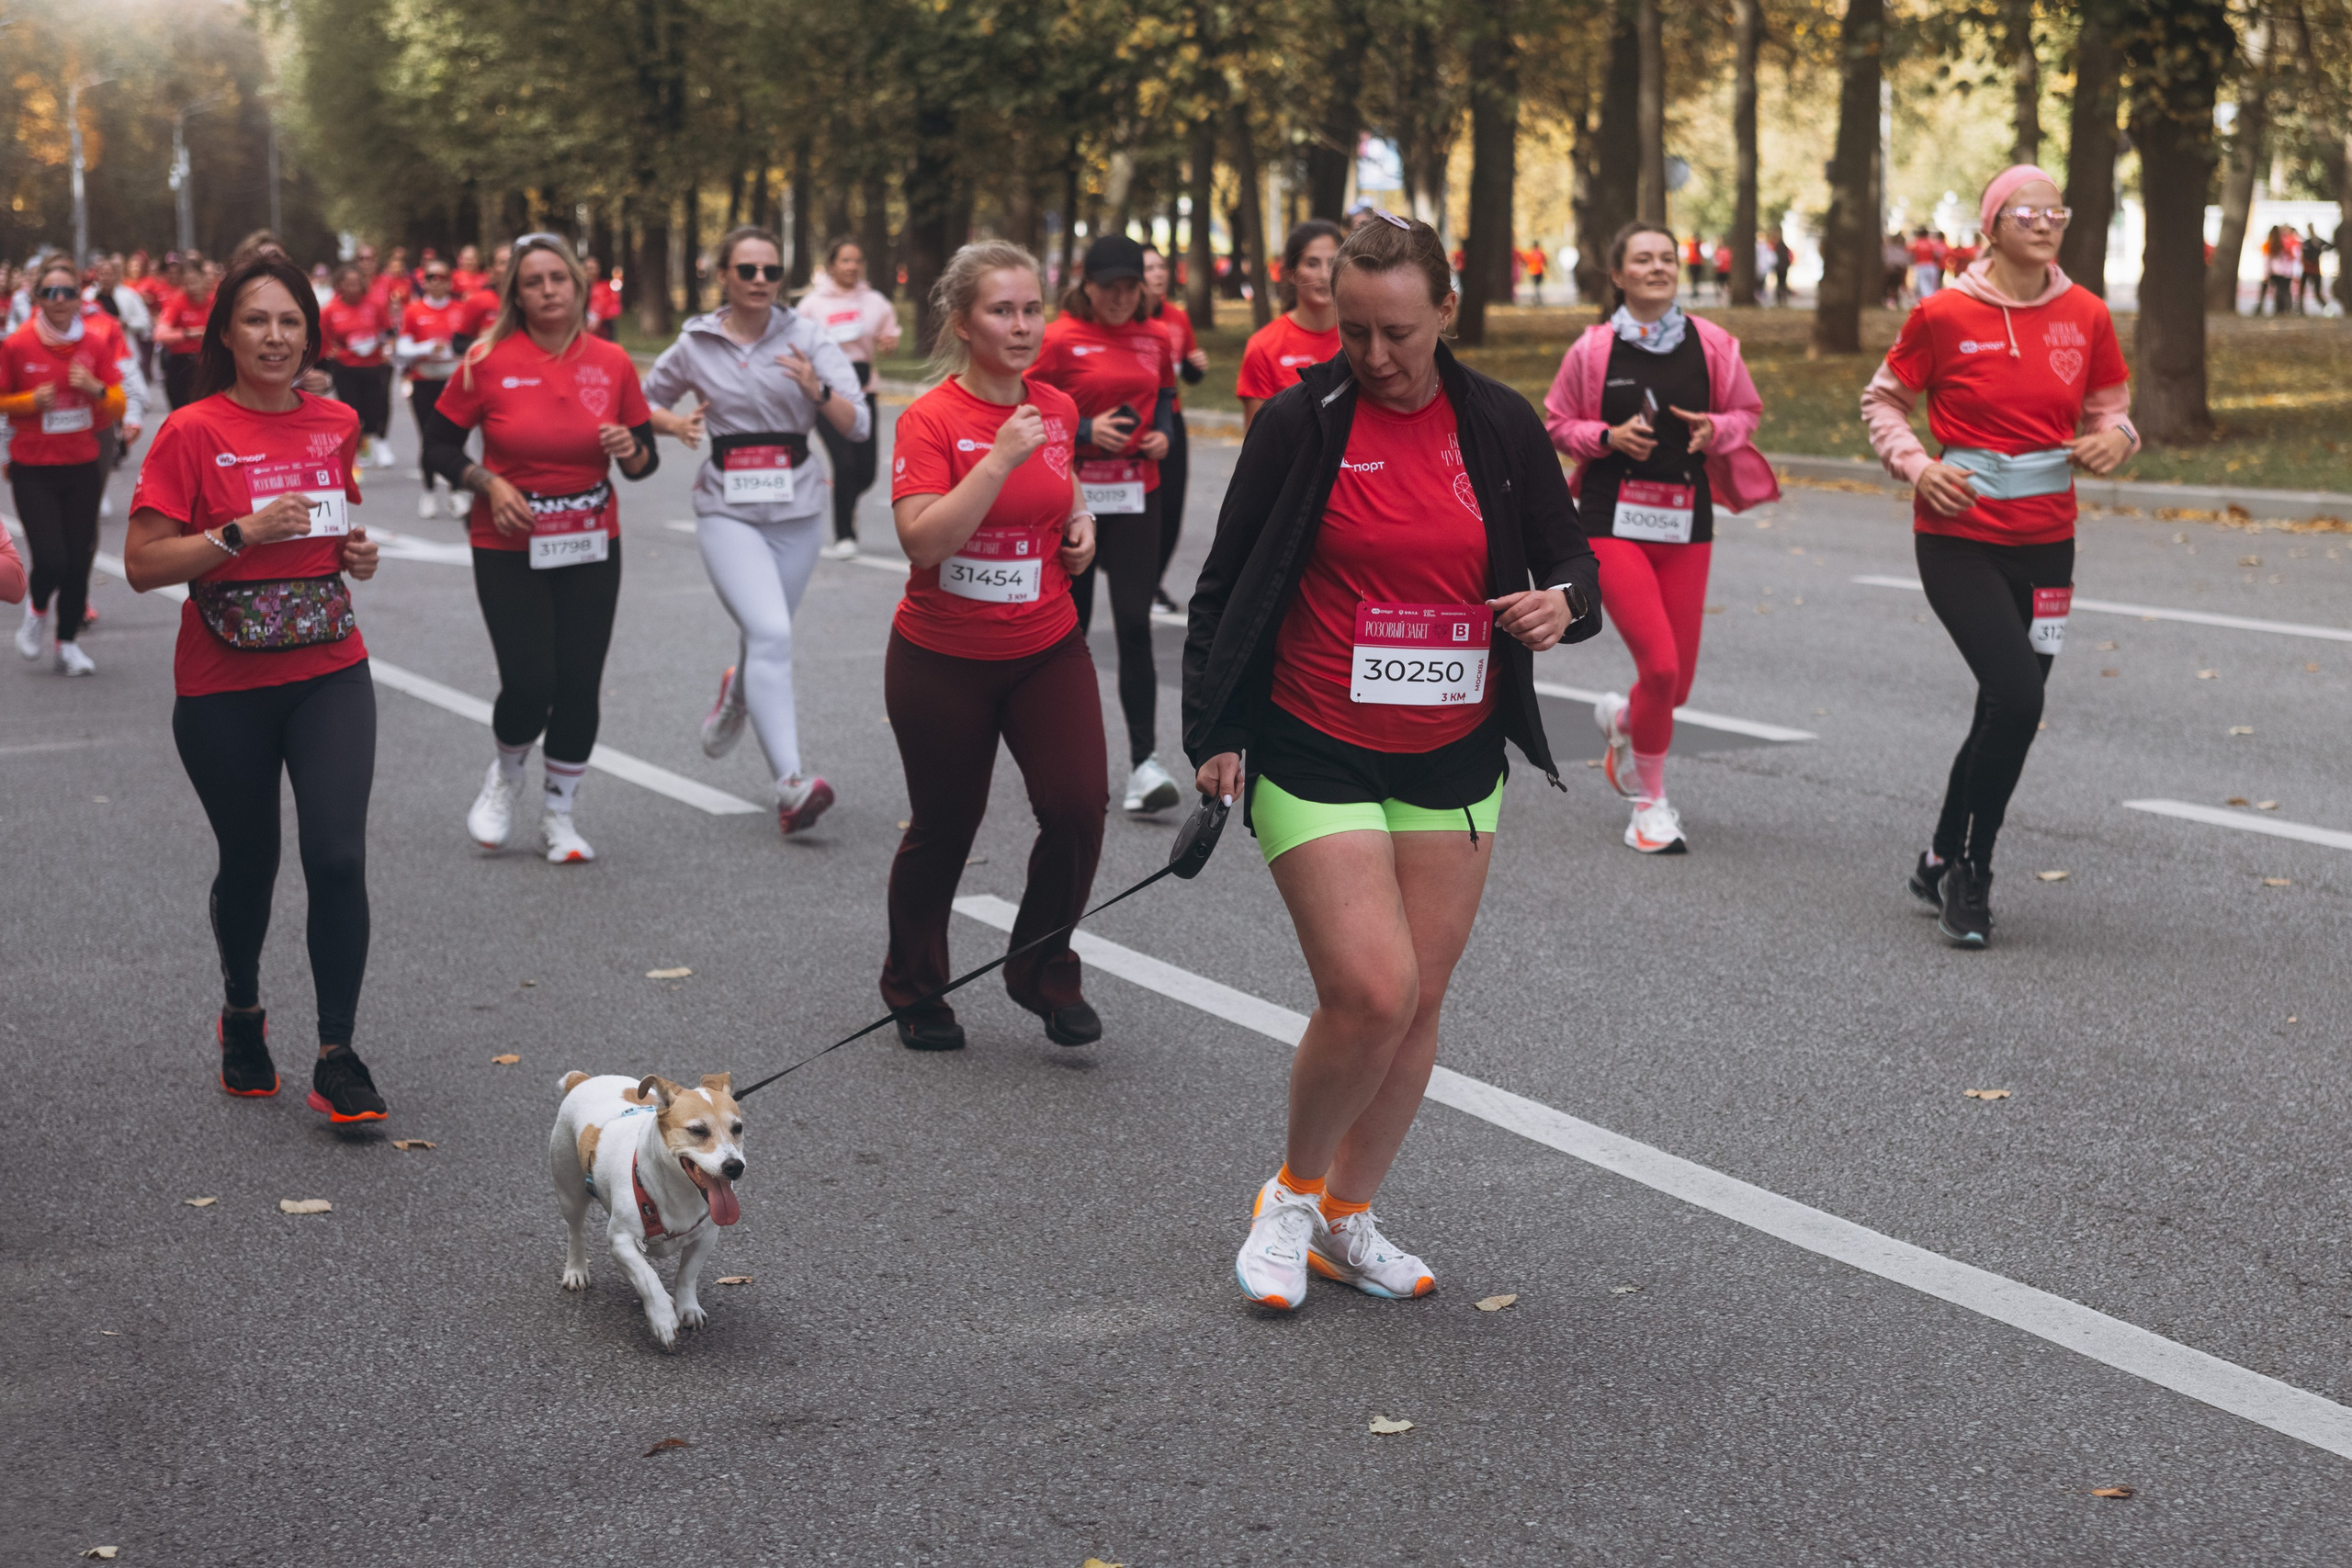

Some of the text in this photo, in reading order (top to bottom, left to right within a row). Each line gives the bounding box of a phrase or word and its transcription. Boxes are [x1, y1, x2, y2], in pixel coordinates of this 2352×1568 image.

[1353, 461, 1385, 473] порт
[1619, 510, 1679, 529] 30054
[538, 538, 592, 557] 31798
[950, 564, 1023, 587] 31454
[1365, 620, 1430, 639] РОЗОВЫЙ ЗАБЕГ
[1363, 658, 1464, 683] 30250
[1475, 658, 1485, 692] МОСКВА
[1442, 692, 1466, 702] 3 КМ
